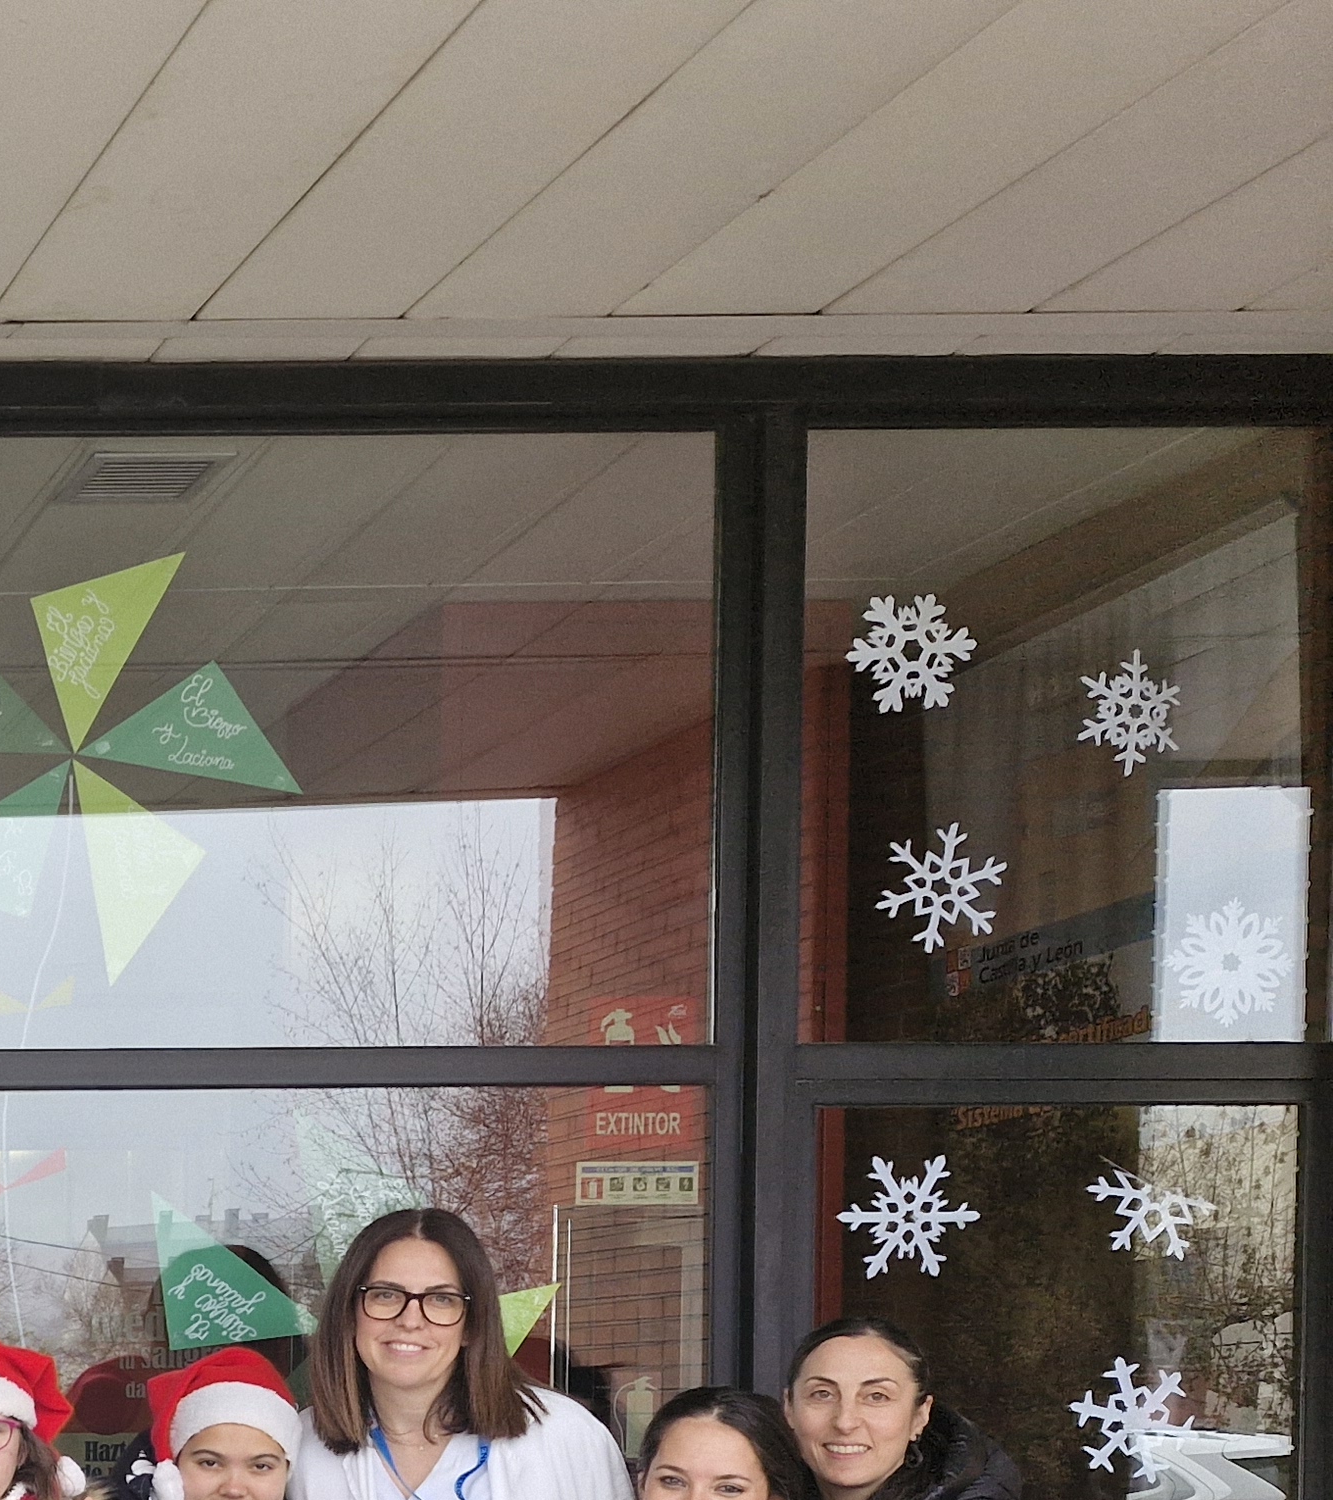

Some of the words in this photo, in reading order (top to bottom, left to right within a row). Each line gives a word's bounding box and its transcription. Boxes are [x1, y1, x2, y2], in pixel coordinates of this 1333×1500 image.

[180, 674, 213, 706] El
[152, 722, 181, 744] y
[596, 1112, 681, 1135] EXTINTOR
